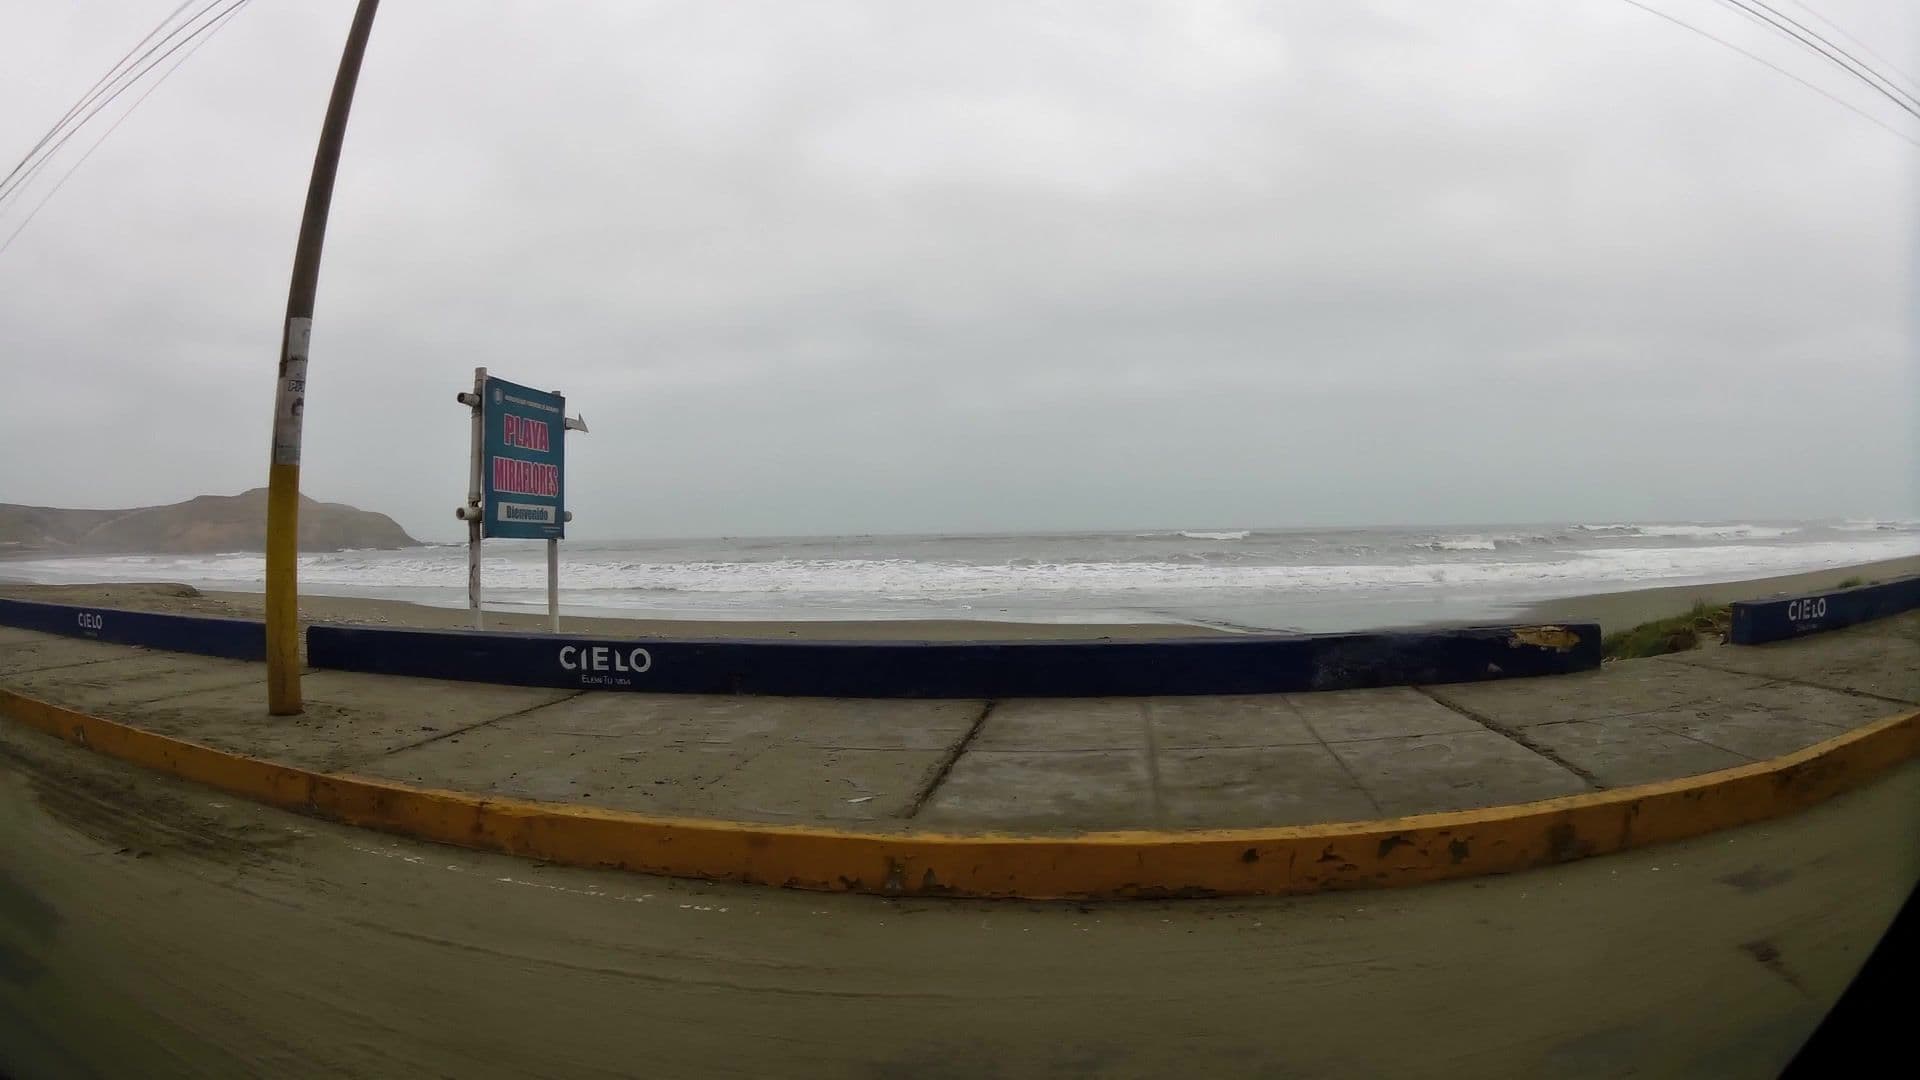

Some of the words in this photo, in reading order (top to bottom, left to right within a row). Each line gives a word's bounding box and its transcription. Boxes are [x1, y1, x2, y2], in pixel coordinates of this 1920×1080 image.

[503, 413, 549, 452] PLAYA
[493, 455, 558, 498] MIRAFLORES
[506, 505, 549, 521] Bienvenido
[78, 612, 103, 630] CIELO
[1788, 598, 1826, 621] CIELO
[560, 645, 651, 673] CIELO
